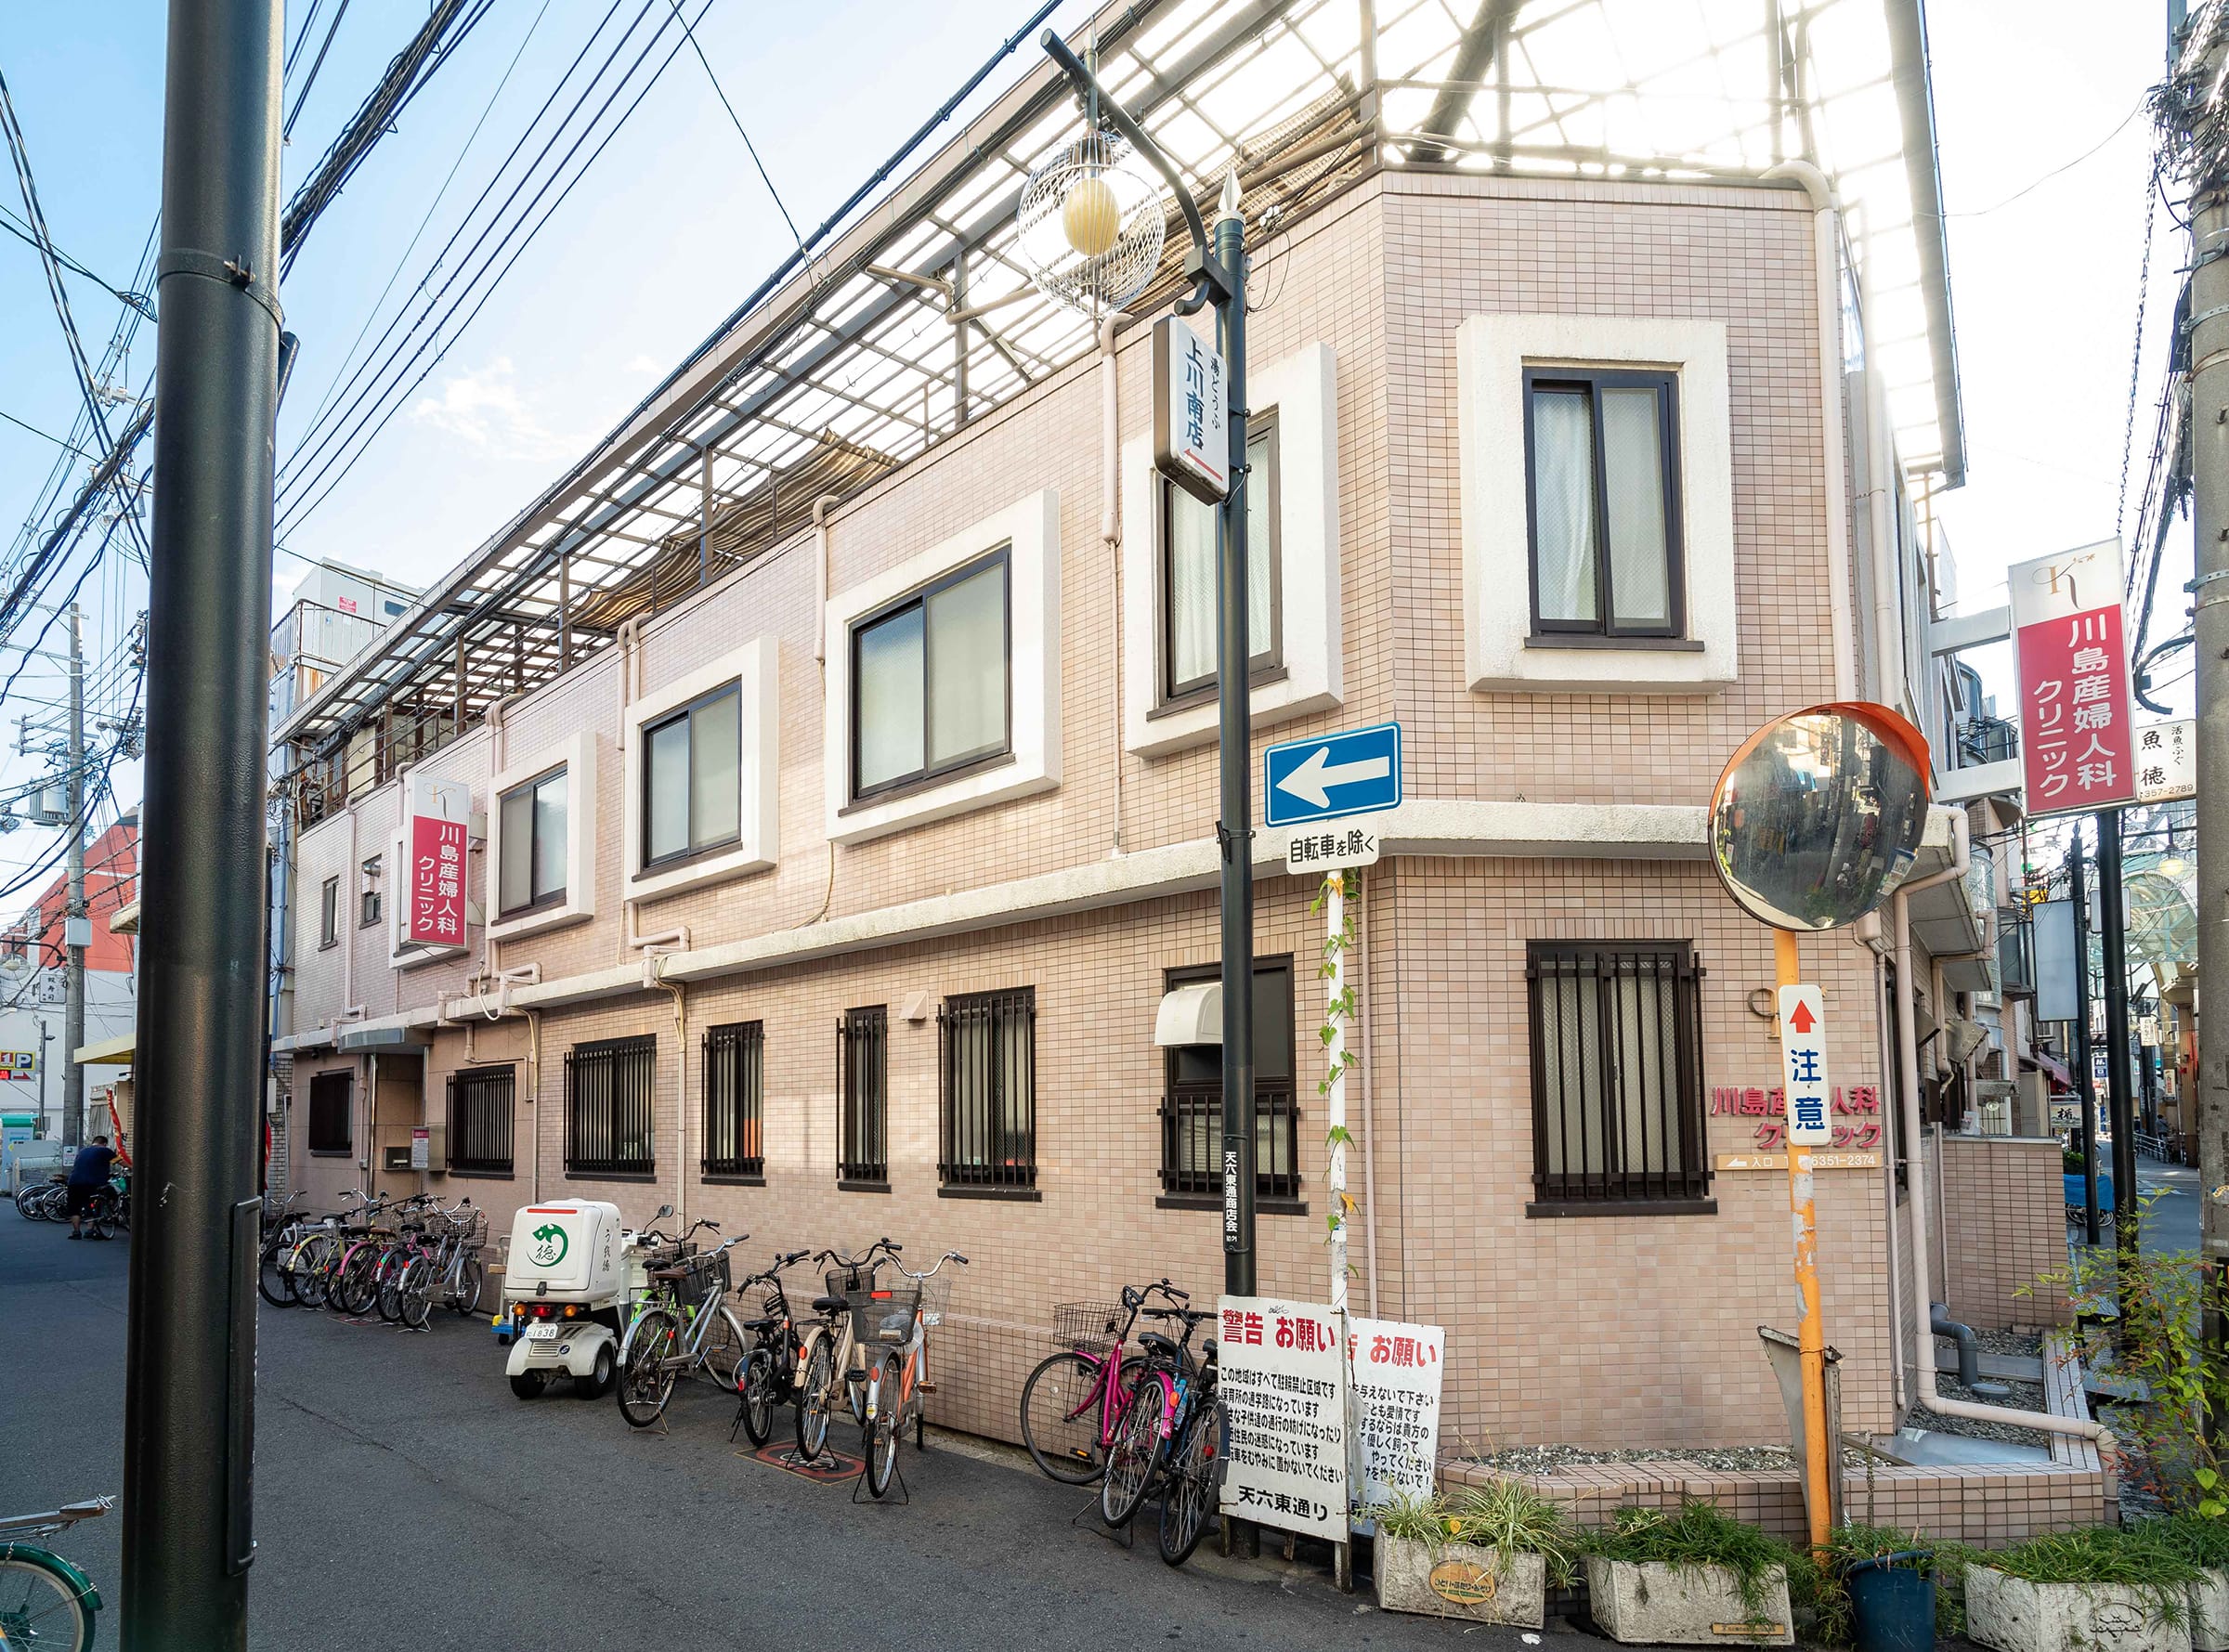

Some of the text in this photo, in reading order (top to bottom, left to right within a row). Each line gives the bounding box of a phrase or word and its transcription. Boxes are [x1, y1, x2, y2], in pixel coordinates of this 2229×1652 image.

[2068, 614, 2117, 791] 川島産婦人科
[2033, 679, 2069, 798] クリニック
[2171, 725, 2183, 766] 活魚ふぐ
[2140, 784, 2193, 798] 357-2789
[1290, 828, 1375, 864] 自転車を除く
[417, 855, 436, 932] クリニック
[437, 825, 460, 936] 川島産婦人科
[1712, 1086, 1881, 1115] 川島産人科
[1790, 1048, 1826, 1130] 注意
[1754, 1122, 1882, 1150] クック
[1752, 1157, 1773, 1167] 入口
[1225, 1151, 1238, 1233] 天六東通商店会
[533, 1329, 554, 1337] 1838
[1222, 1308, 1264, 1346] 警告
[1275, 1316, 1336, 1353] お願い
[1369, 1333, 1437, 1368] お願い
[1220, 1367, 1336, 1399] この地域はすべて駐輪禁止区域です
[1220, 1387, 1320, 1419] 保育所の通学路になっています
[1363, 1402, 1421, 1424] とも愛情です
[1227, 1407, 1341, 1443] さな子供達の通行の妨げになったり
[1229, 1426, 1319, 1461] 近住民の迷惑になっています
[1229, 1446, 1344, 1484] 転車をむやみに置かないでください
[1238, 1485, 1328, 1521] 天六東通り
